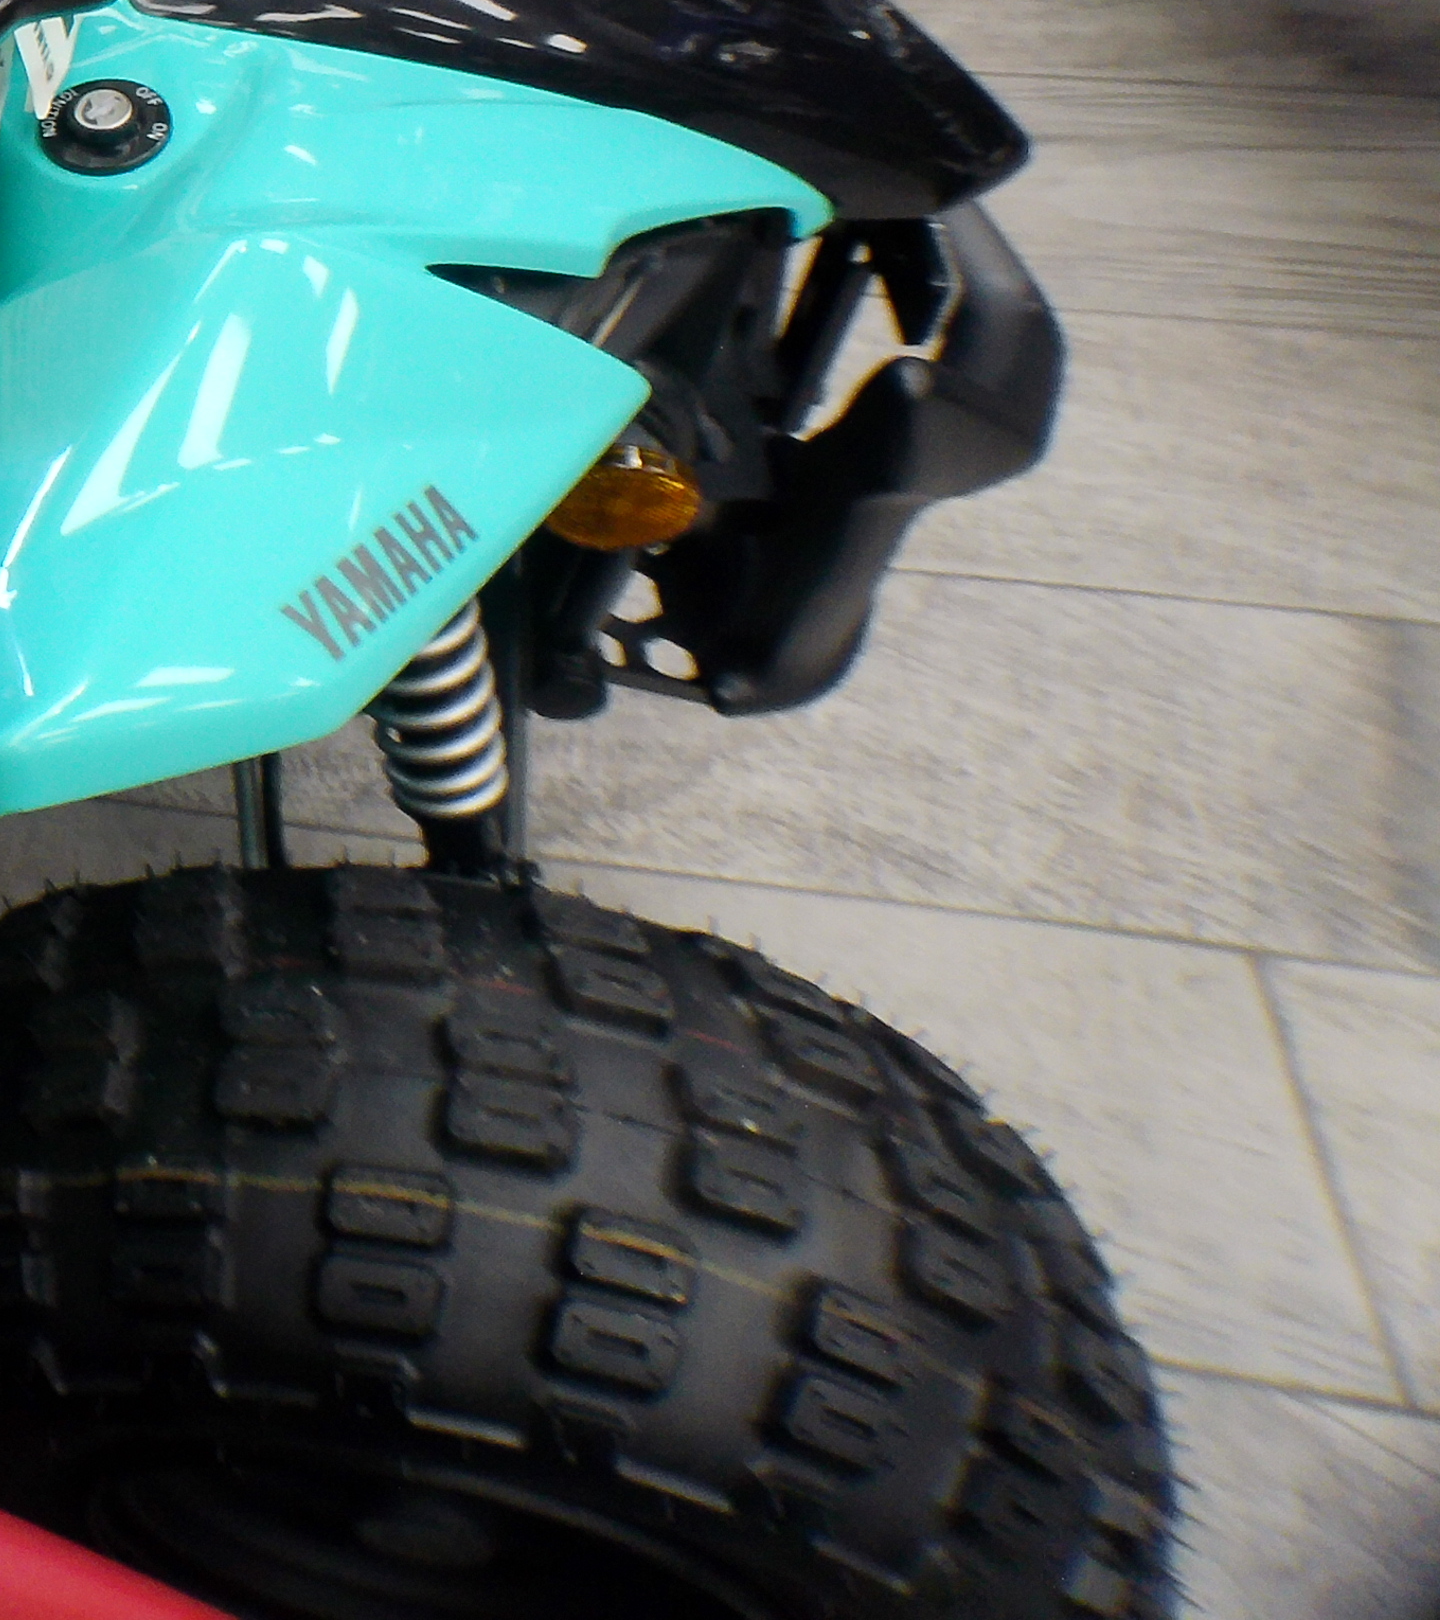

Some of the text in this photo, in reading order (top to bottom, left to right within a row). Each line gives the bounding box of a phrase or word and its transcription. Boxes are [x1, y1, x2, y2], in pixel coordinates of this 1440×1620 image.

[135, 86, 164, 107] OFF
[146, 122, 169, 142] ON
[279, 483, 480, 664] YAMAHA
